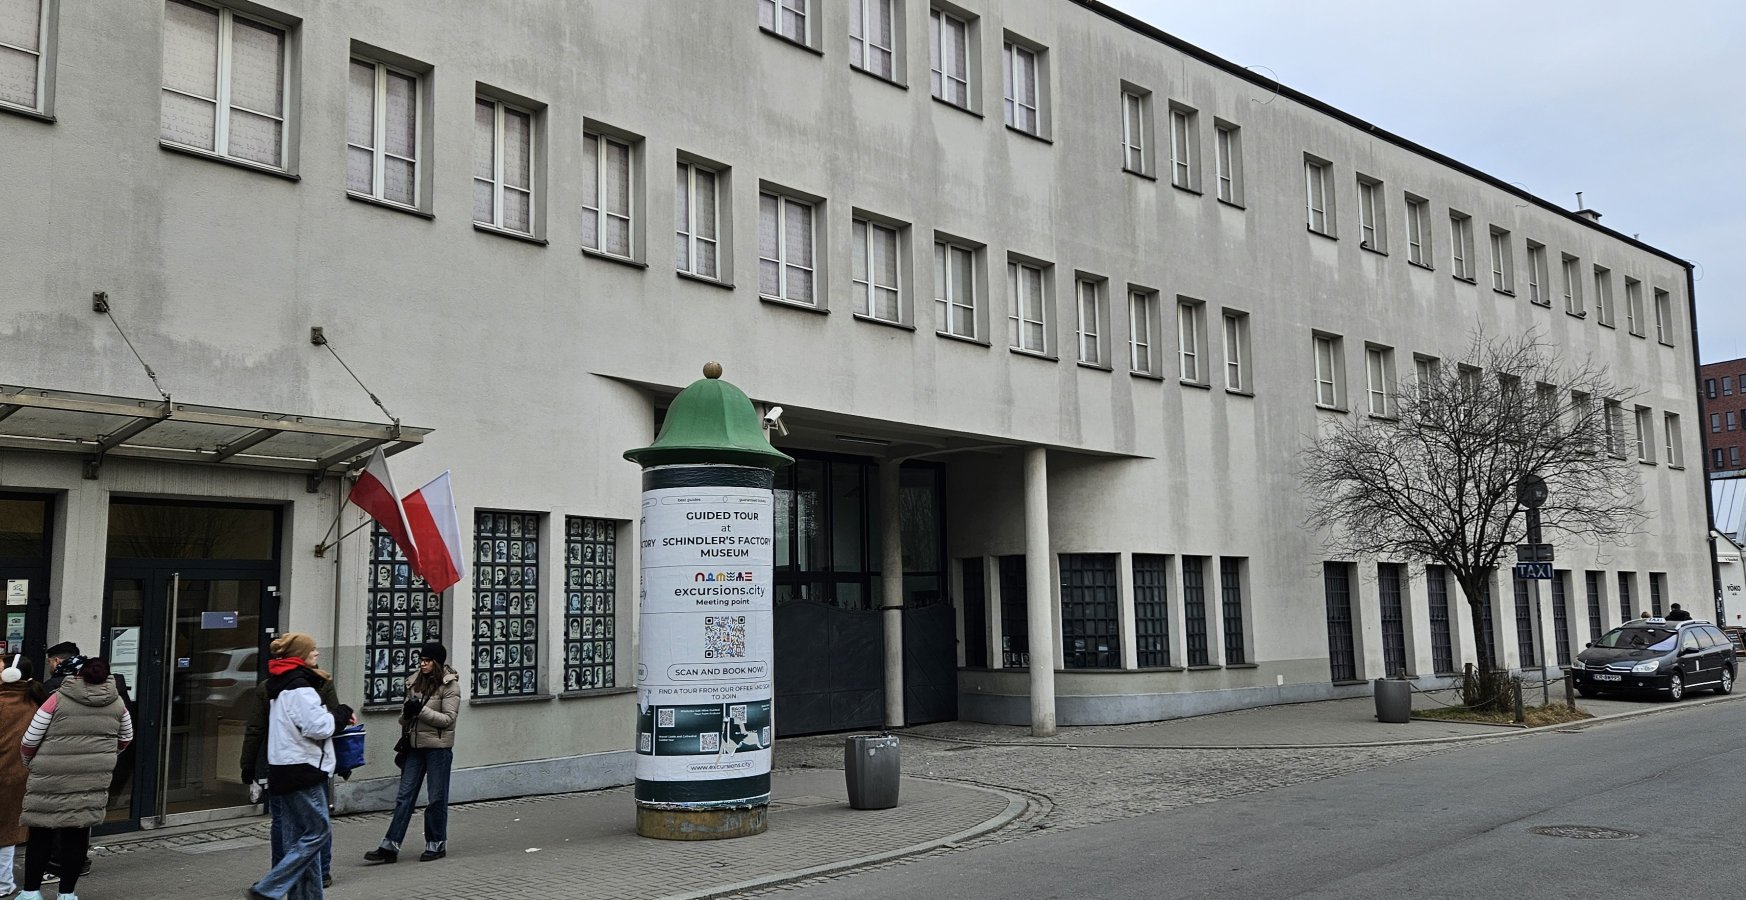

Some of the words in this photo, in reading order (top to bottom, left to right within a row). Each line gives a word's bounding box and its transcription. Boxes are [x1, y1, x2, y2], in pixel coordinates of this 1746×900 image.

[686, 511, 731, 520] GUIDED
[733, 511, 759, 520] TOUR
[721, 524, 731, 532] at
[662, 536, 735, 546] SCHINDLER'S
[738, 537, 771, 545] FACTORY
[700, 549, 749, 557] MUSEUM
[1517, 564, 1552, 578] TAXI
[674, 585, 765, 597] excursions.city
[722, 666, 746, 674] BOOK
